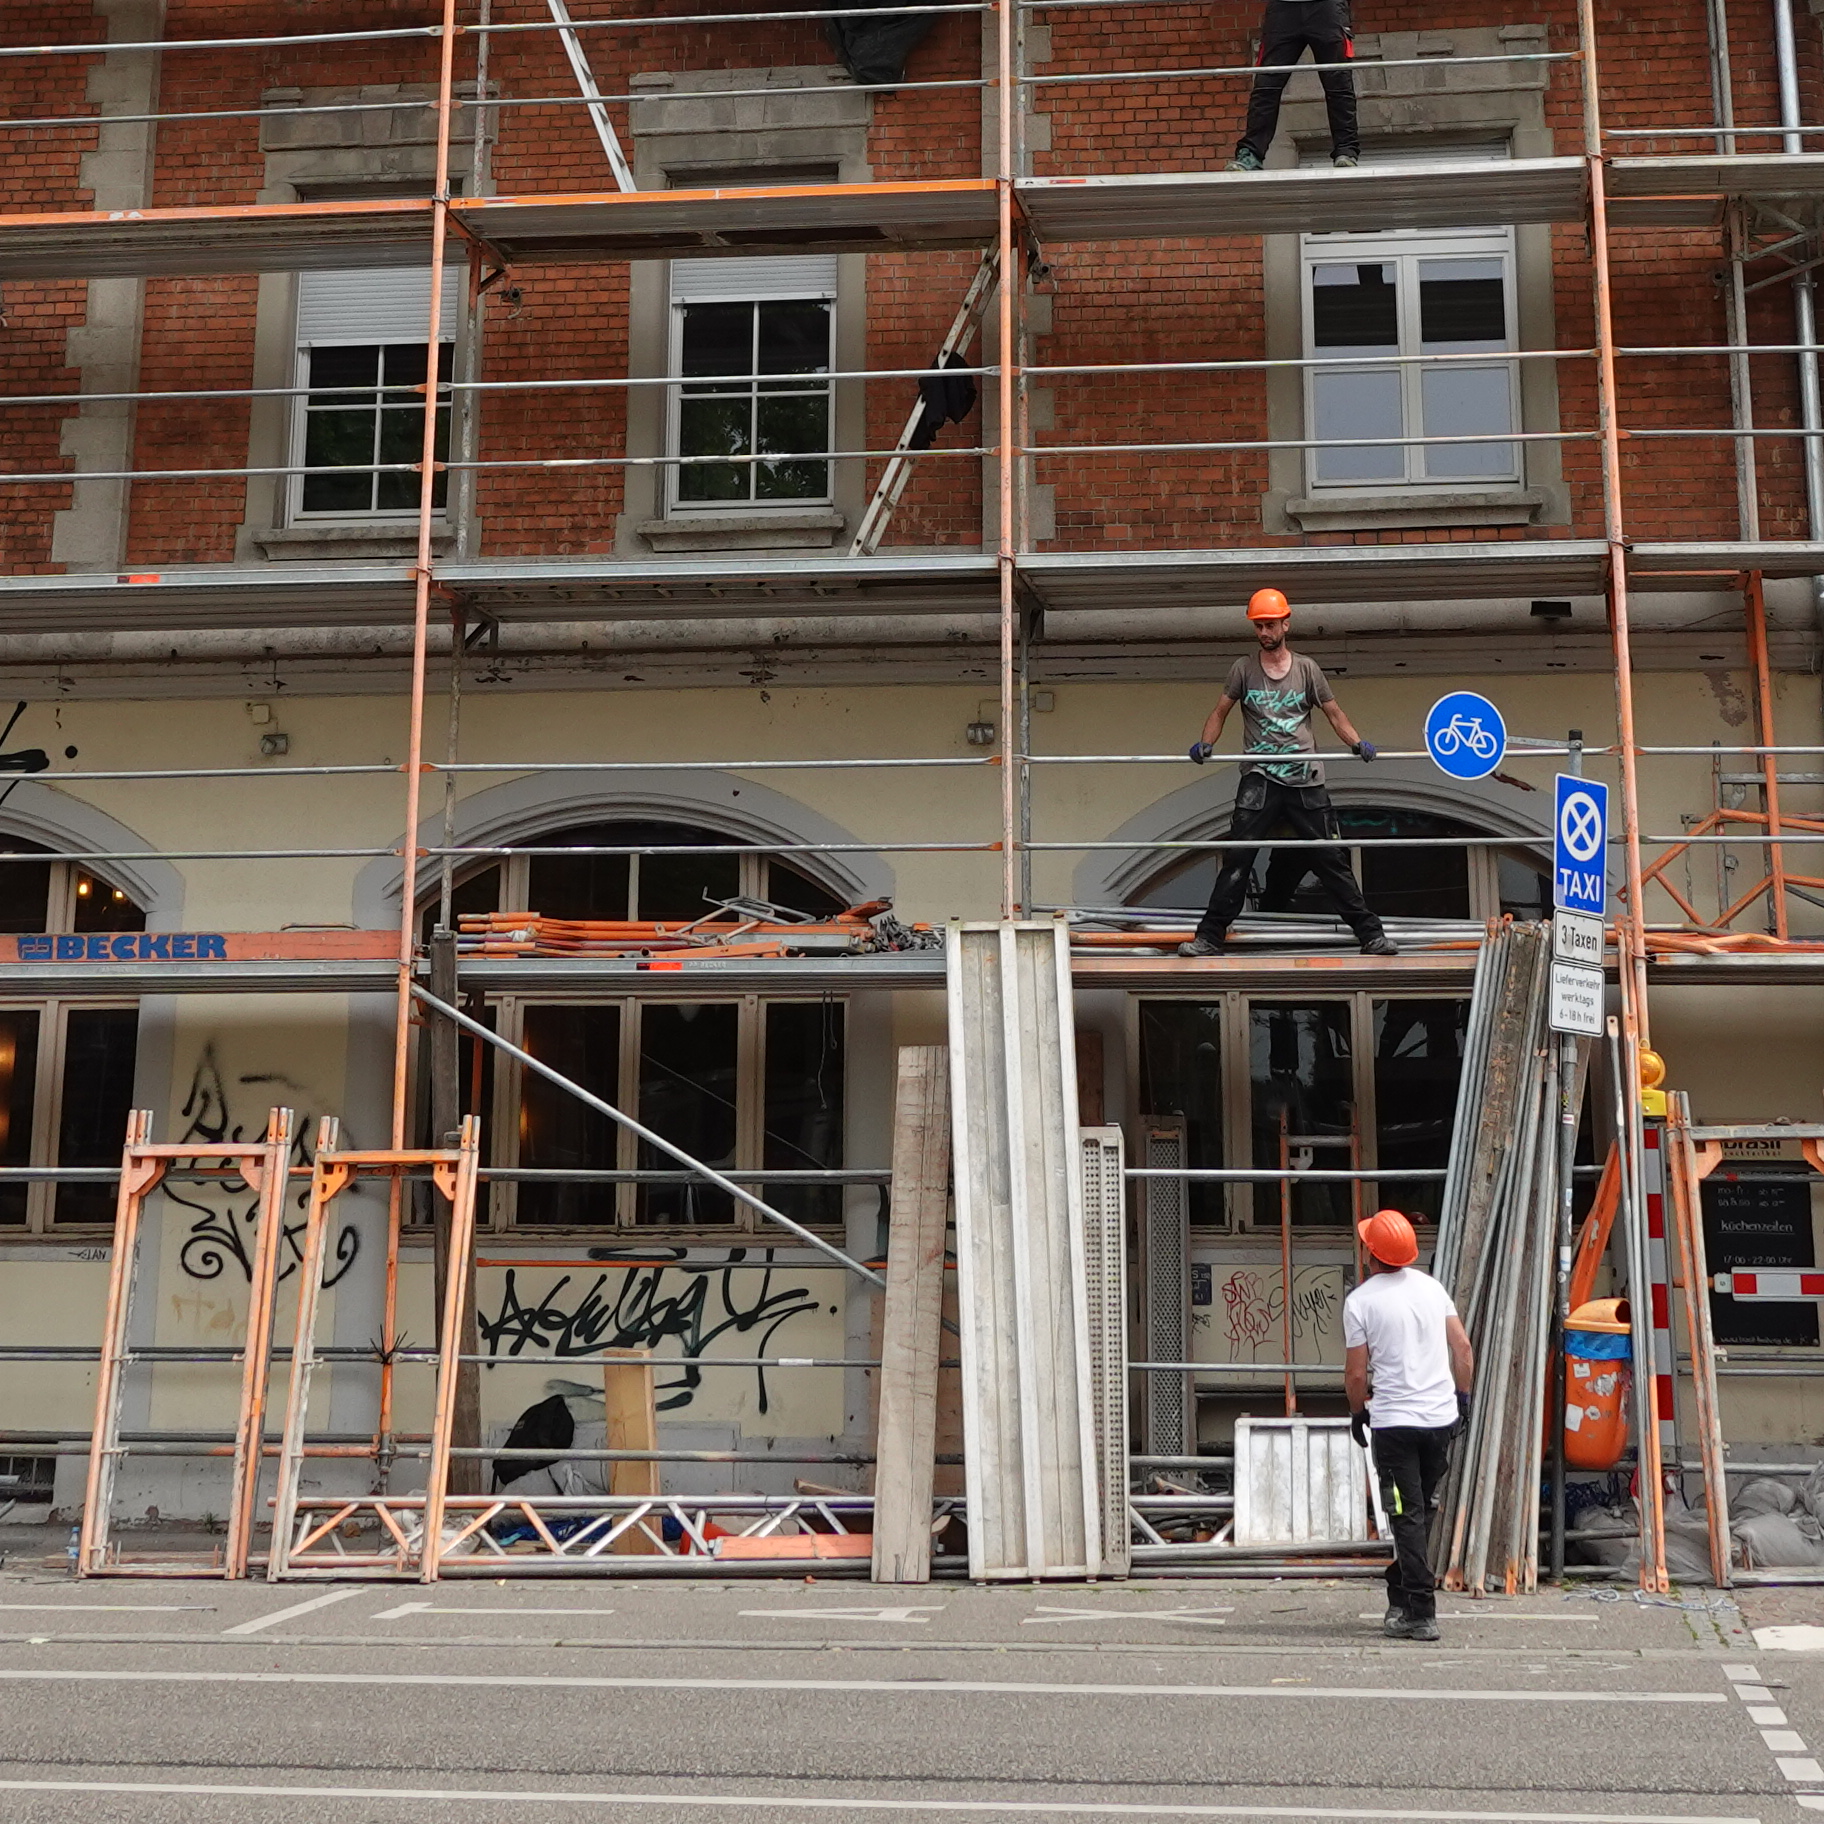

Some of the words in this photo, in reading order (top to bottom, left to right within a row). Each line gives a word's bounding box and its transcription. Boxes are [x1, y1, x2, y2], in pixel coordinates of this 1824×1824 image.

[1560, 868, 1601, 903] TAXI
[56, 935, 227, 959] BECKER
[1562, 925, 1569, 945] 3
[1570, 927, 1598, 951] Taxen
[1555, 972, 1601, 991] Lieferverkehr
[1561, 991, 1595, 1008] werktags
